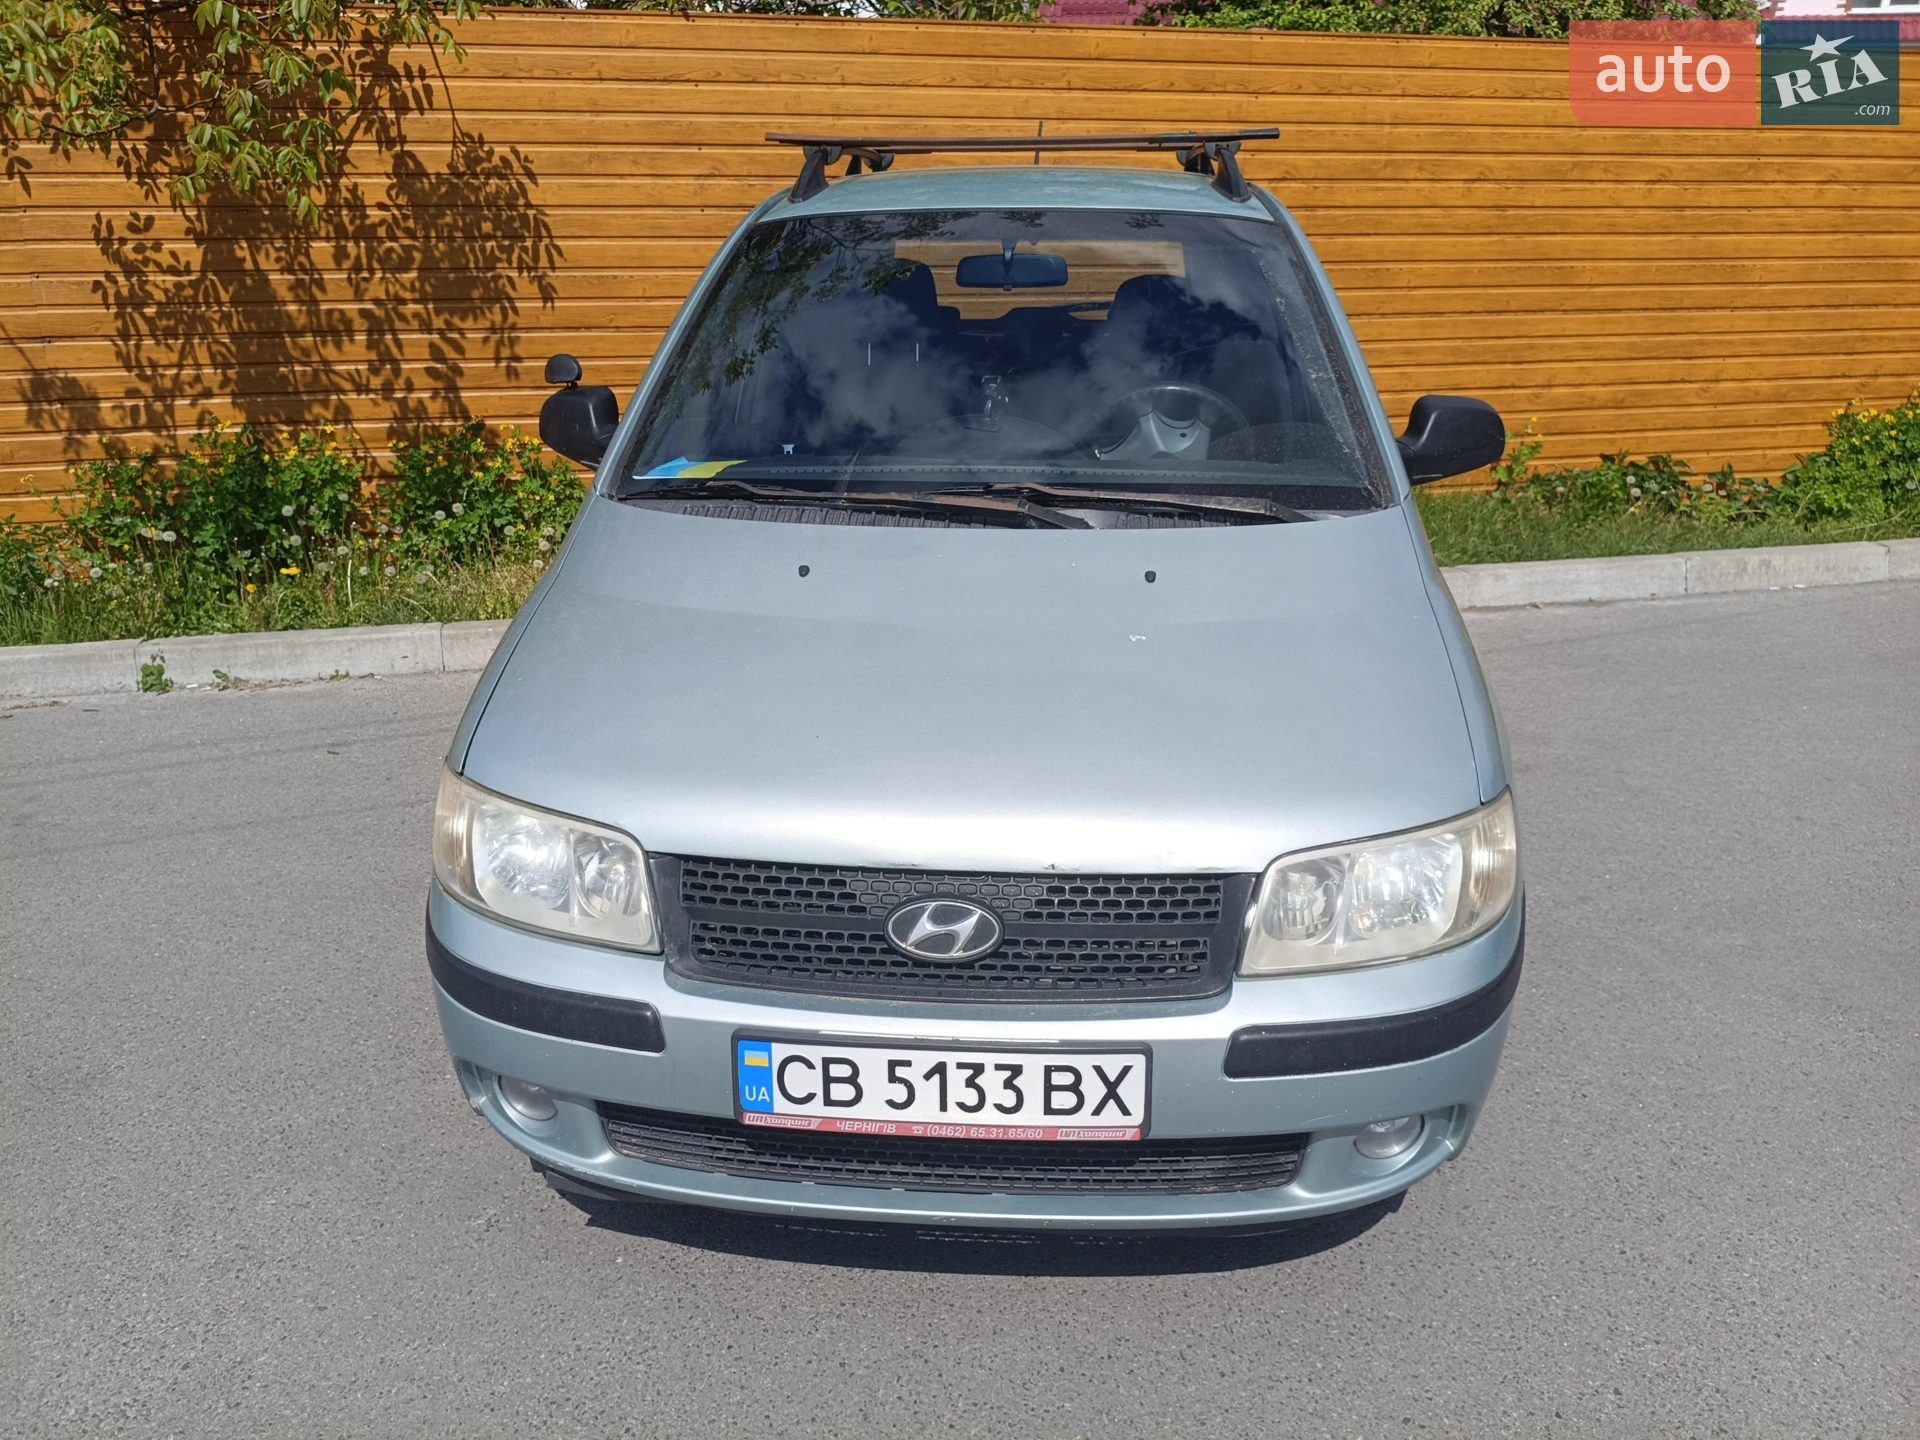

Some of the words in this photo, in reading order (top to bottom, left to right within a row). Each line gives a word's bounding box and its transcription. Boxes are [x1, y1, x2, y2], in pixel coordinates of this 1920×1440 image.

[745, 1086, 770, 1103] UA
[776, 1054, 864, 1108] CB
[885, 1059, 1024, 1115] 5133
[1043, 1064, 1134, 1117] BX
[836, 1120, 897, 1133] ЧЕРНІГІВ
[927, 1124, 966, 1138] (0462)
